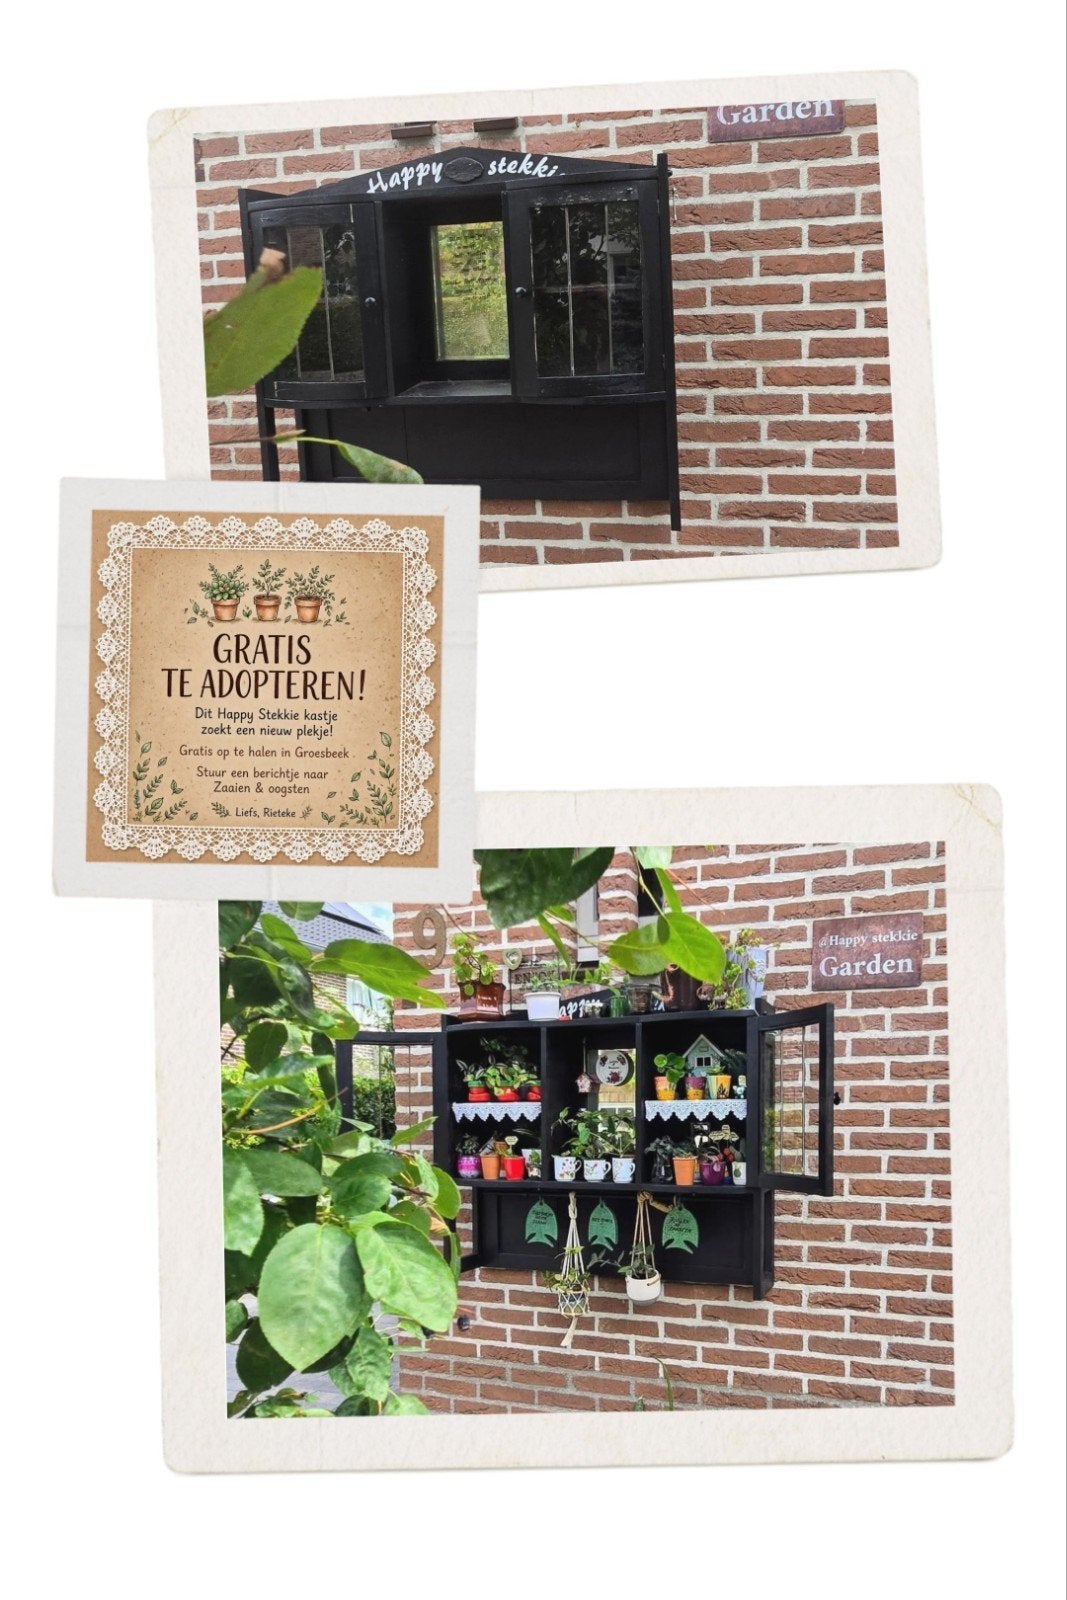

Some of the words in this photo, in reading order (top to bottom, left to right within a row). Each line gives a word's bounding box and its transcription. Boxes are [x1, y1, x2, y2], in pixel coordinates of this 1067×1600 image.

[366, 162, 444, 194] Happy
[487, 153, 566, 178] stekki
[412, 907, 447, 970] 9
[872, 929, 918, 944] stekkie
[820, 952, 914, 977] Garden
